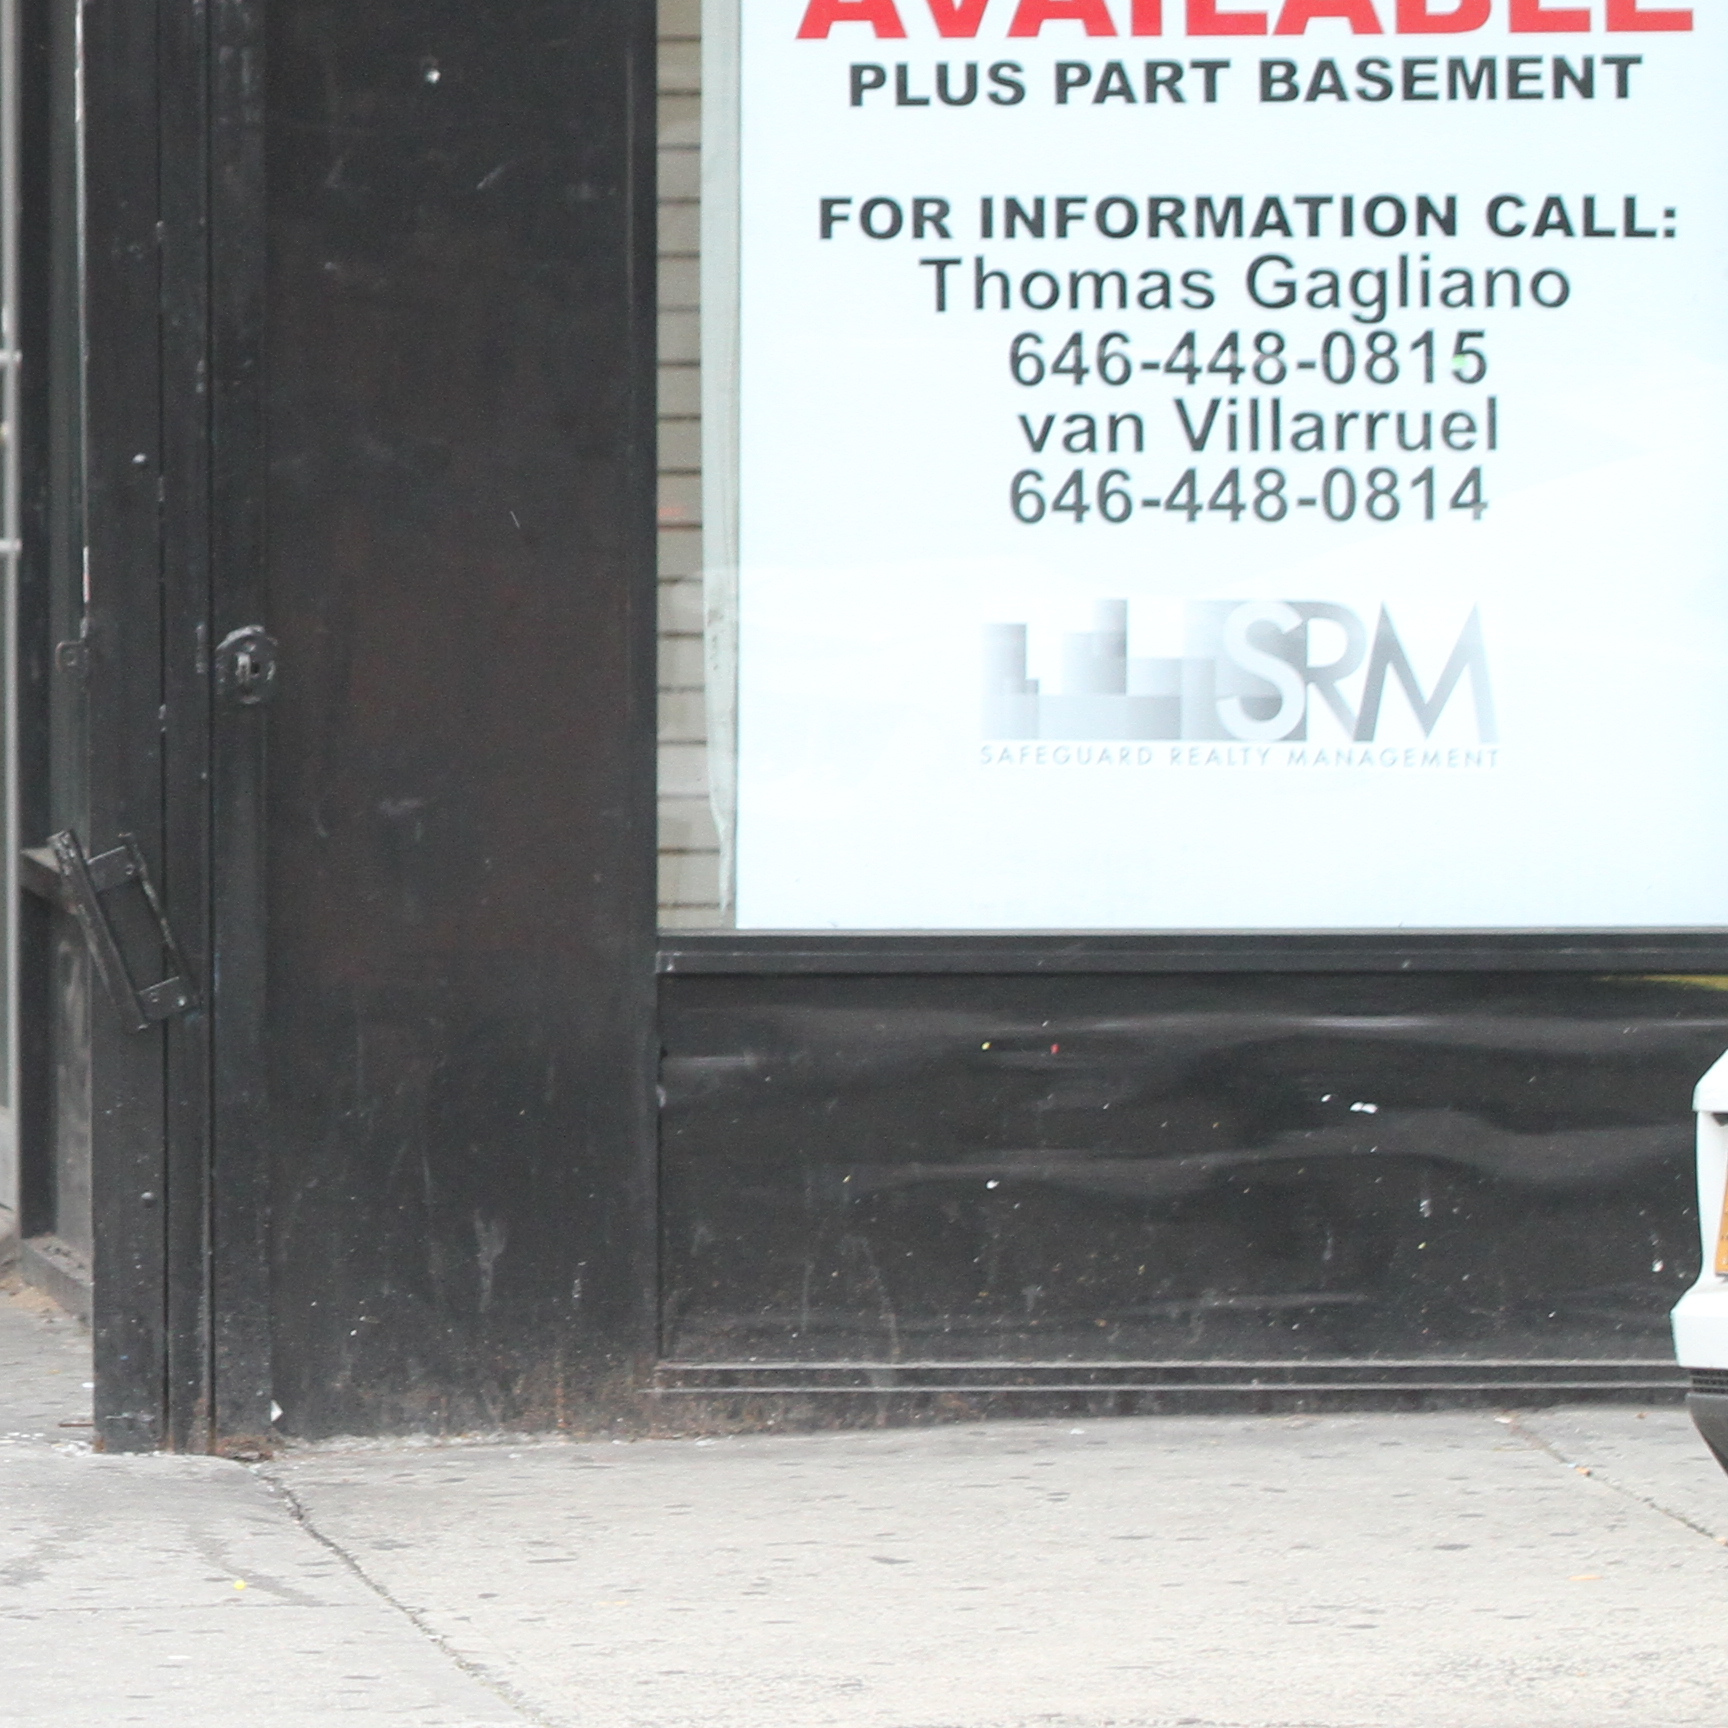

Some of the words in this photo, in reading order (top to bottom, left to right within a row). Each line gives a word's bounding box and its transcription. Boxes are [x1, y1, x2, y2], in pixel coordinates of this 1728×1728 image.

[849, 61, 1026, 108] PLUS
[1054, 58, 1230, 105] PART
[1259, 55, 1644, 104] BASEMENT
[819, 196, 953, 240] FOR
[979, 194, 1458, 239] INFORMATION
[1486, 193, 1679, 238] CALL:
[920, 256, 1216, 312] Thomas
[1246, 254, 1572, 323] Gagliano
[1008, 331, 1490, 387] 646-448-0815
[1018, 408, 1145, 455] van
[1175, 398, 1500, 453] Villarruel
[1008, 466, 1490, 526] 646-448-0814
[979, 745, 1154, 768] SAFEGUARD
[1170, 745, 1270, 768] REALTY
[1287, 746, 1501, 770] MANAGEMENT
